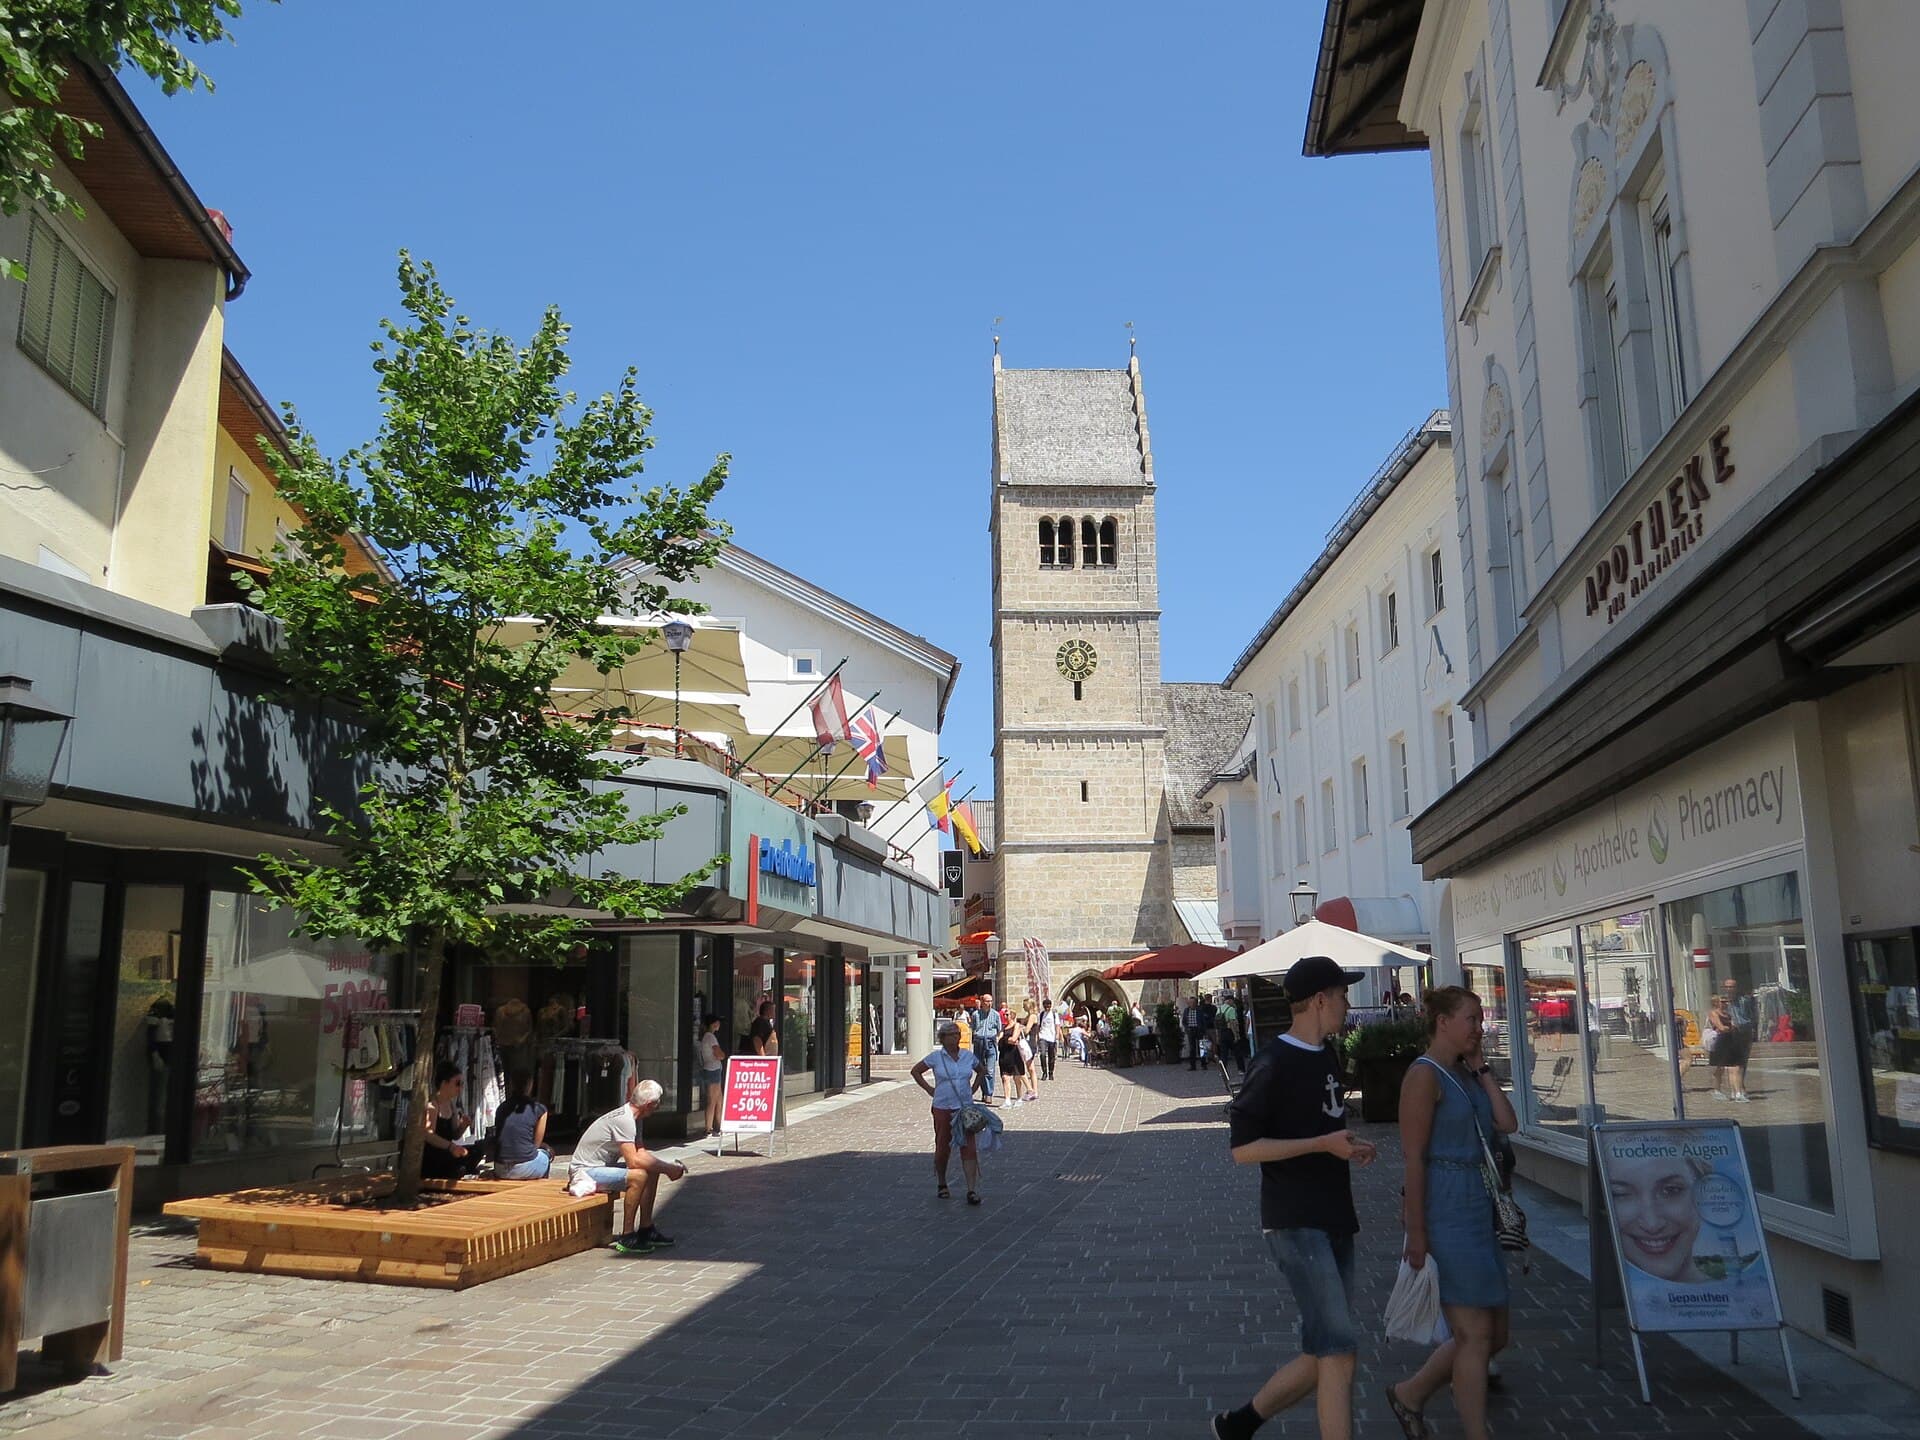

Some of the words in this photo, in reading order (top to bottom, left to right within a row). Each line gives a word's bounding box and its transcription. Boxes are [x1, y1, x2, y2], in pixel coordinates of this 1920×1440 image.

[1585, 425, 1735, 616] APOTHEKE
[1630, 513, 1703, 598] MARIAHILF
[1504, 866, 1546, 903] Pharmacy
[1573, 822, 1638, 886] Apotheke
[1679, 766, 1783, 840] Pharmacy
[736, 1072, 771, 1082] TOTAL-
[732, 1098, 768, 1112] -50%
[1612, 1143, 1677, 1158] trockene
[1682, 1143, 1728, 1160] Augen
[1668, 1292, 1729, 1304] Bepanthen
